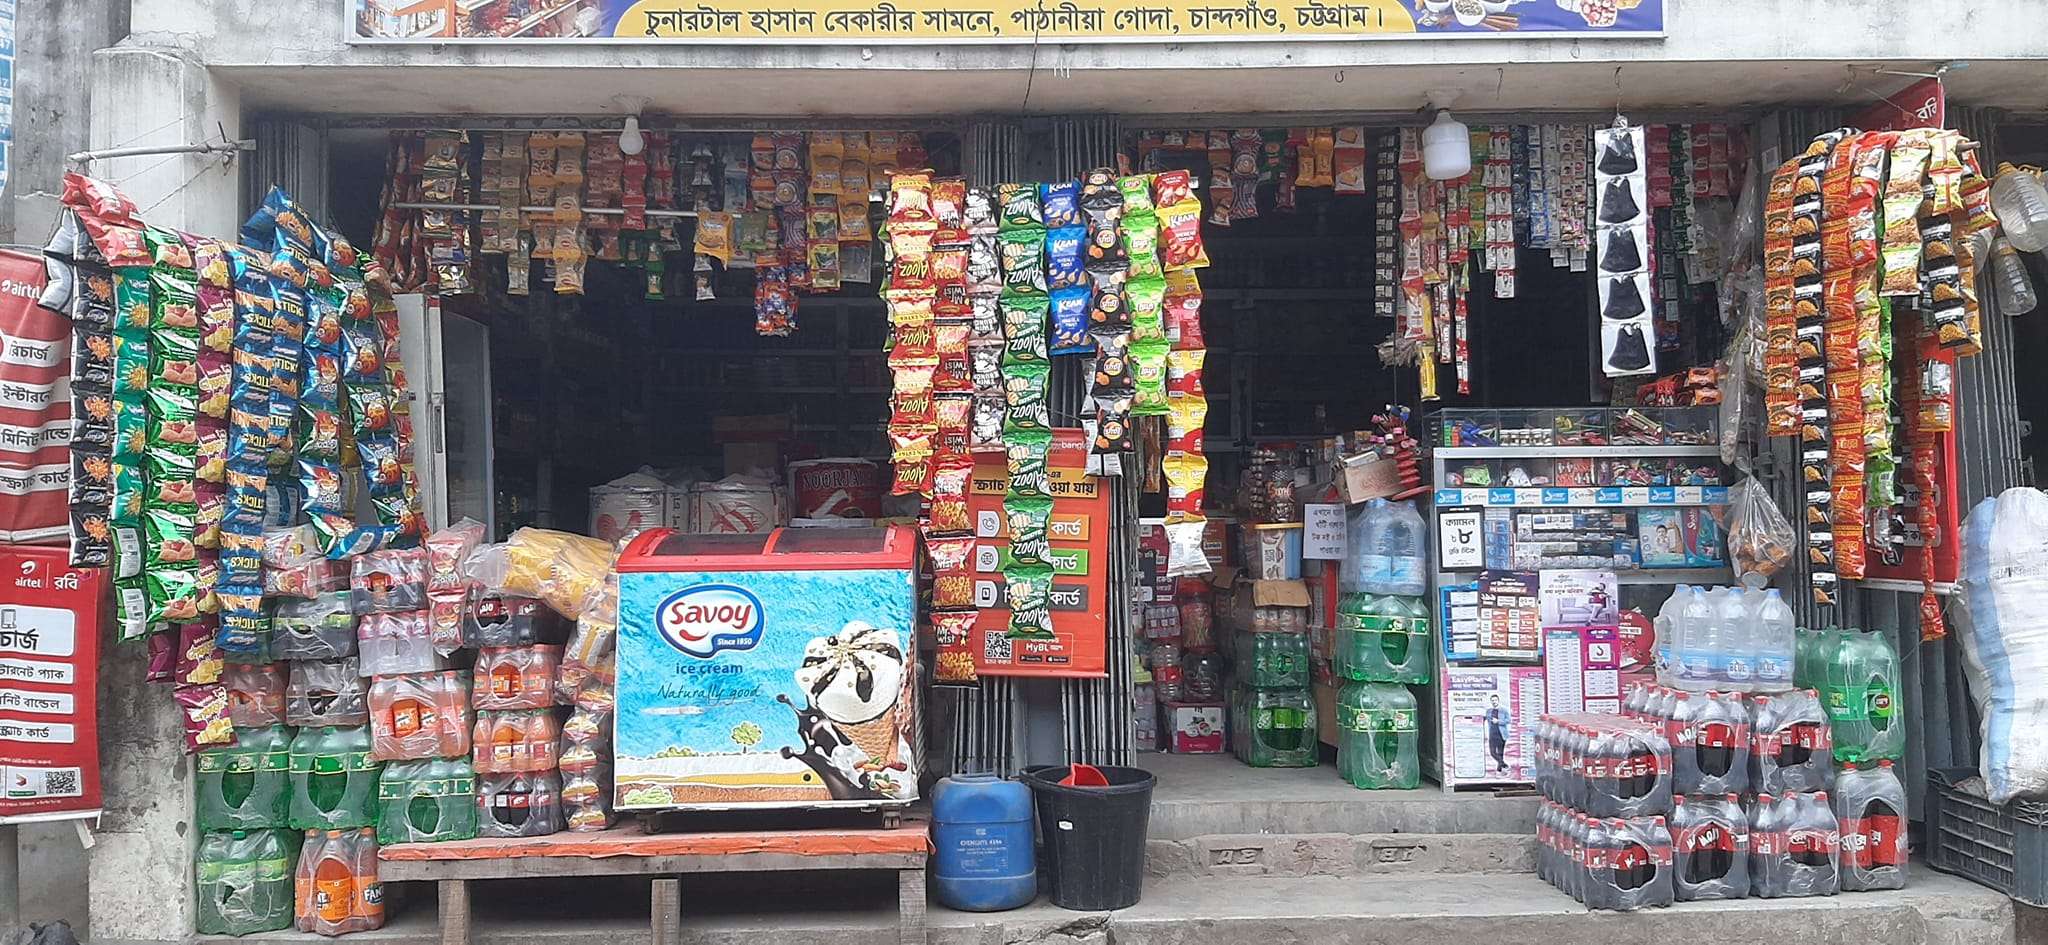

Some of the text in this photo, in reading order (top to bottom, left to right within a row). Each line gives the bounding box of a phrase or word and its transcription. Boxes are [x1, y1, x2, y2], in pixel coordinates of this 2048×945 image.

[748, 8, 816, 34] হাসান
[824, 3, 915, 32] বেকারীর
[922, 8, 1000, 34] সামনে,
[1051, 520, 1081, 536] কার্ড
[54, 572, 79, 590] রবি
[1050, 591, 1081, 606] কার্ড
[670, 601, 752, 629] Savoy
[675, 663, 743, 675] ice cream
[657, 685, 761, 706] Naturally good
